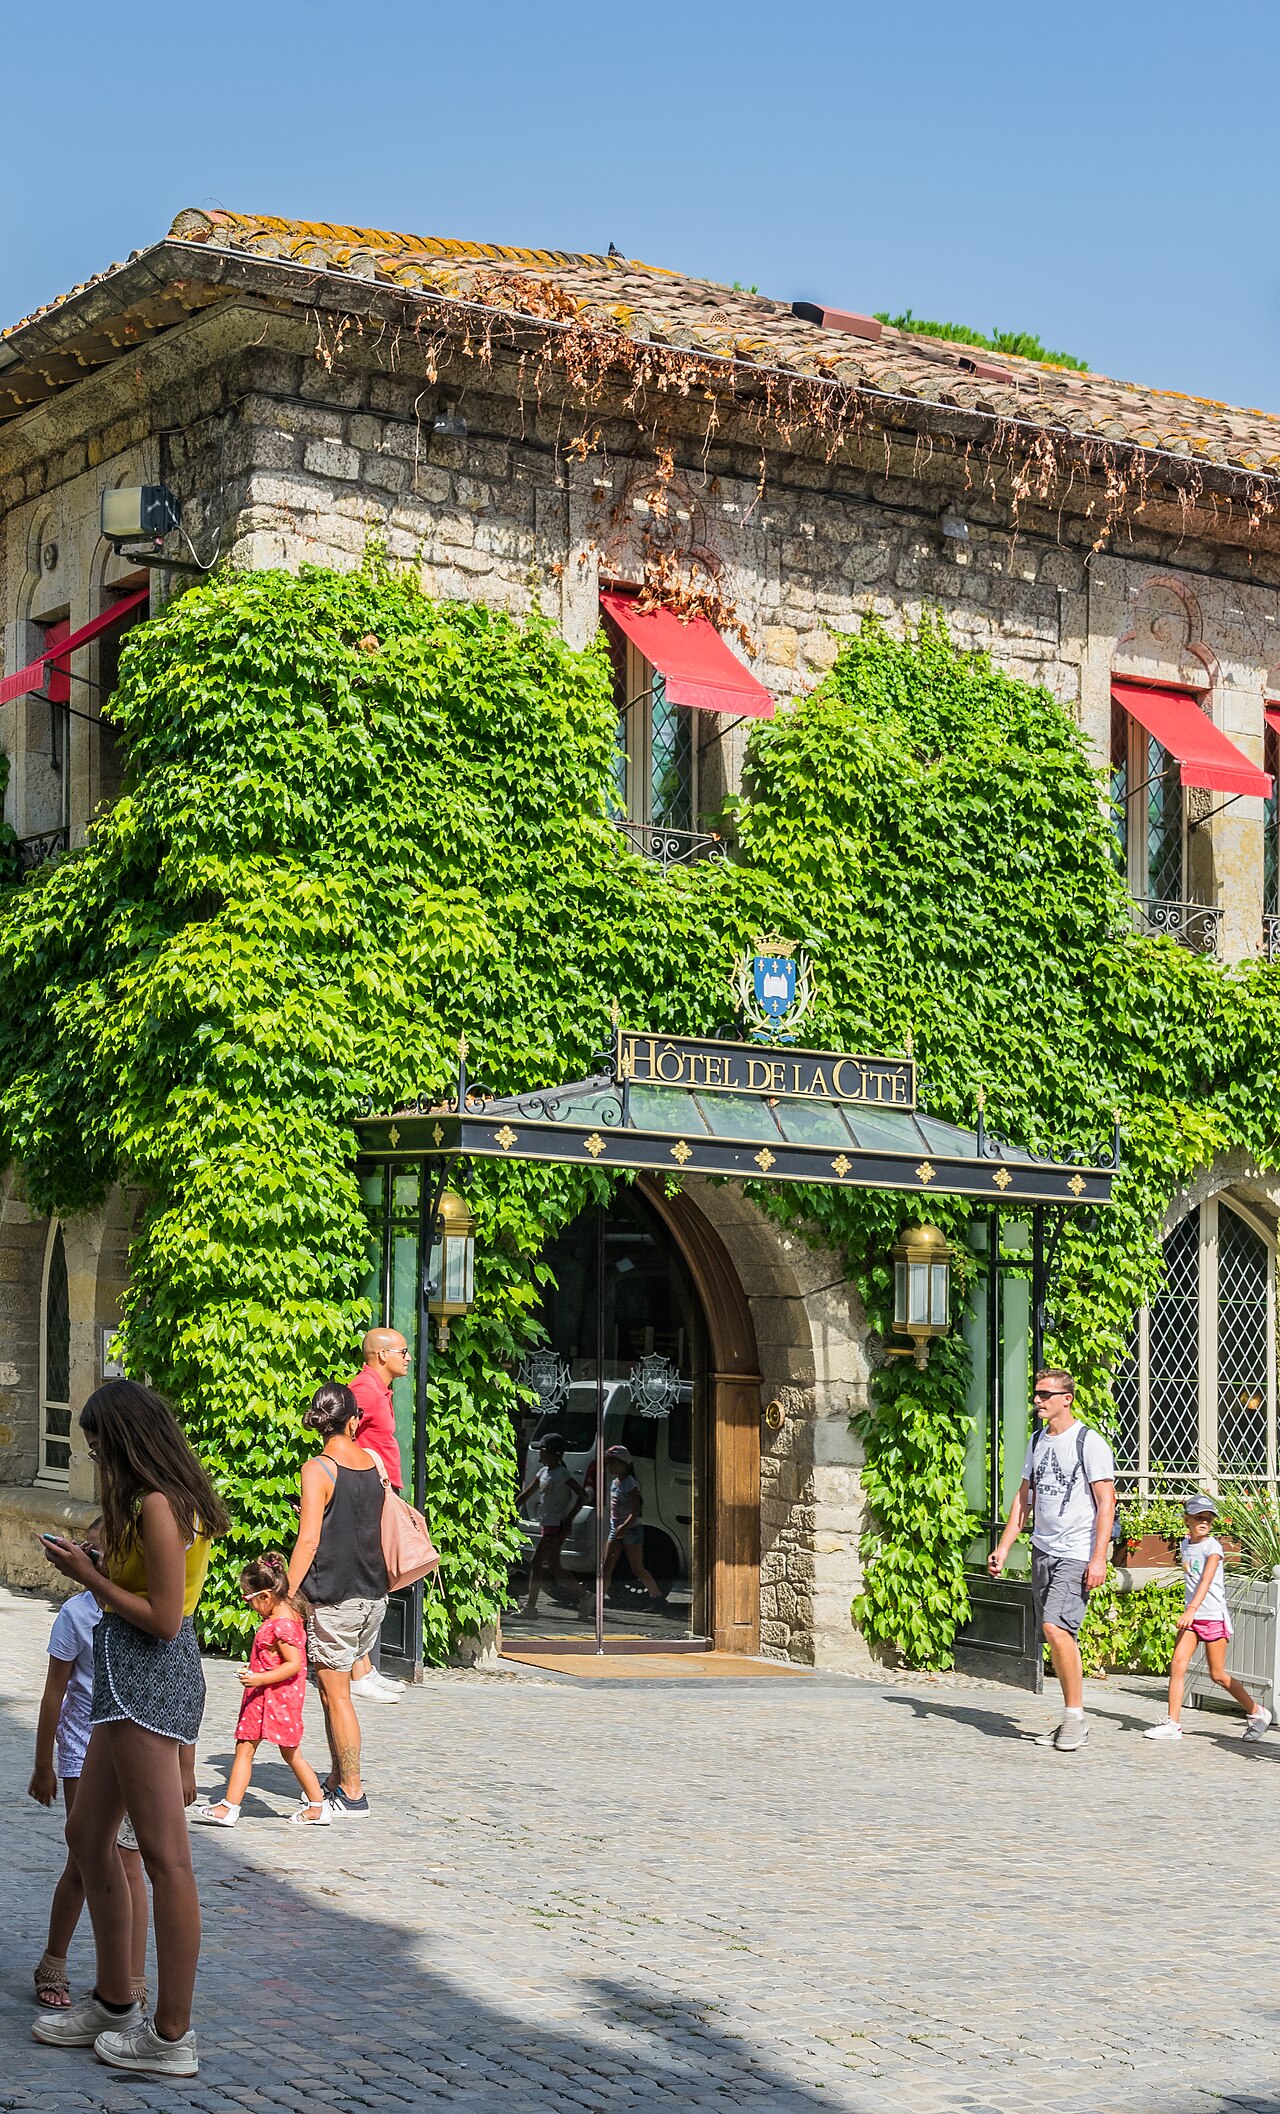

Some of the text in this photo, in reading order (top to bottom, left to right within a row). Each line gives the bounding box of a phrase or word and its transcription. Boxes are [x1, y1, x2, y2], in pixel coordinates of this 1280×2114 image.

[625, 1038, 739, 1088] HÔTEL
[745, 1059, 786, 1092] DE
[791, 1064, 832, 1096] LA
